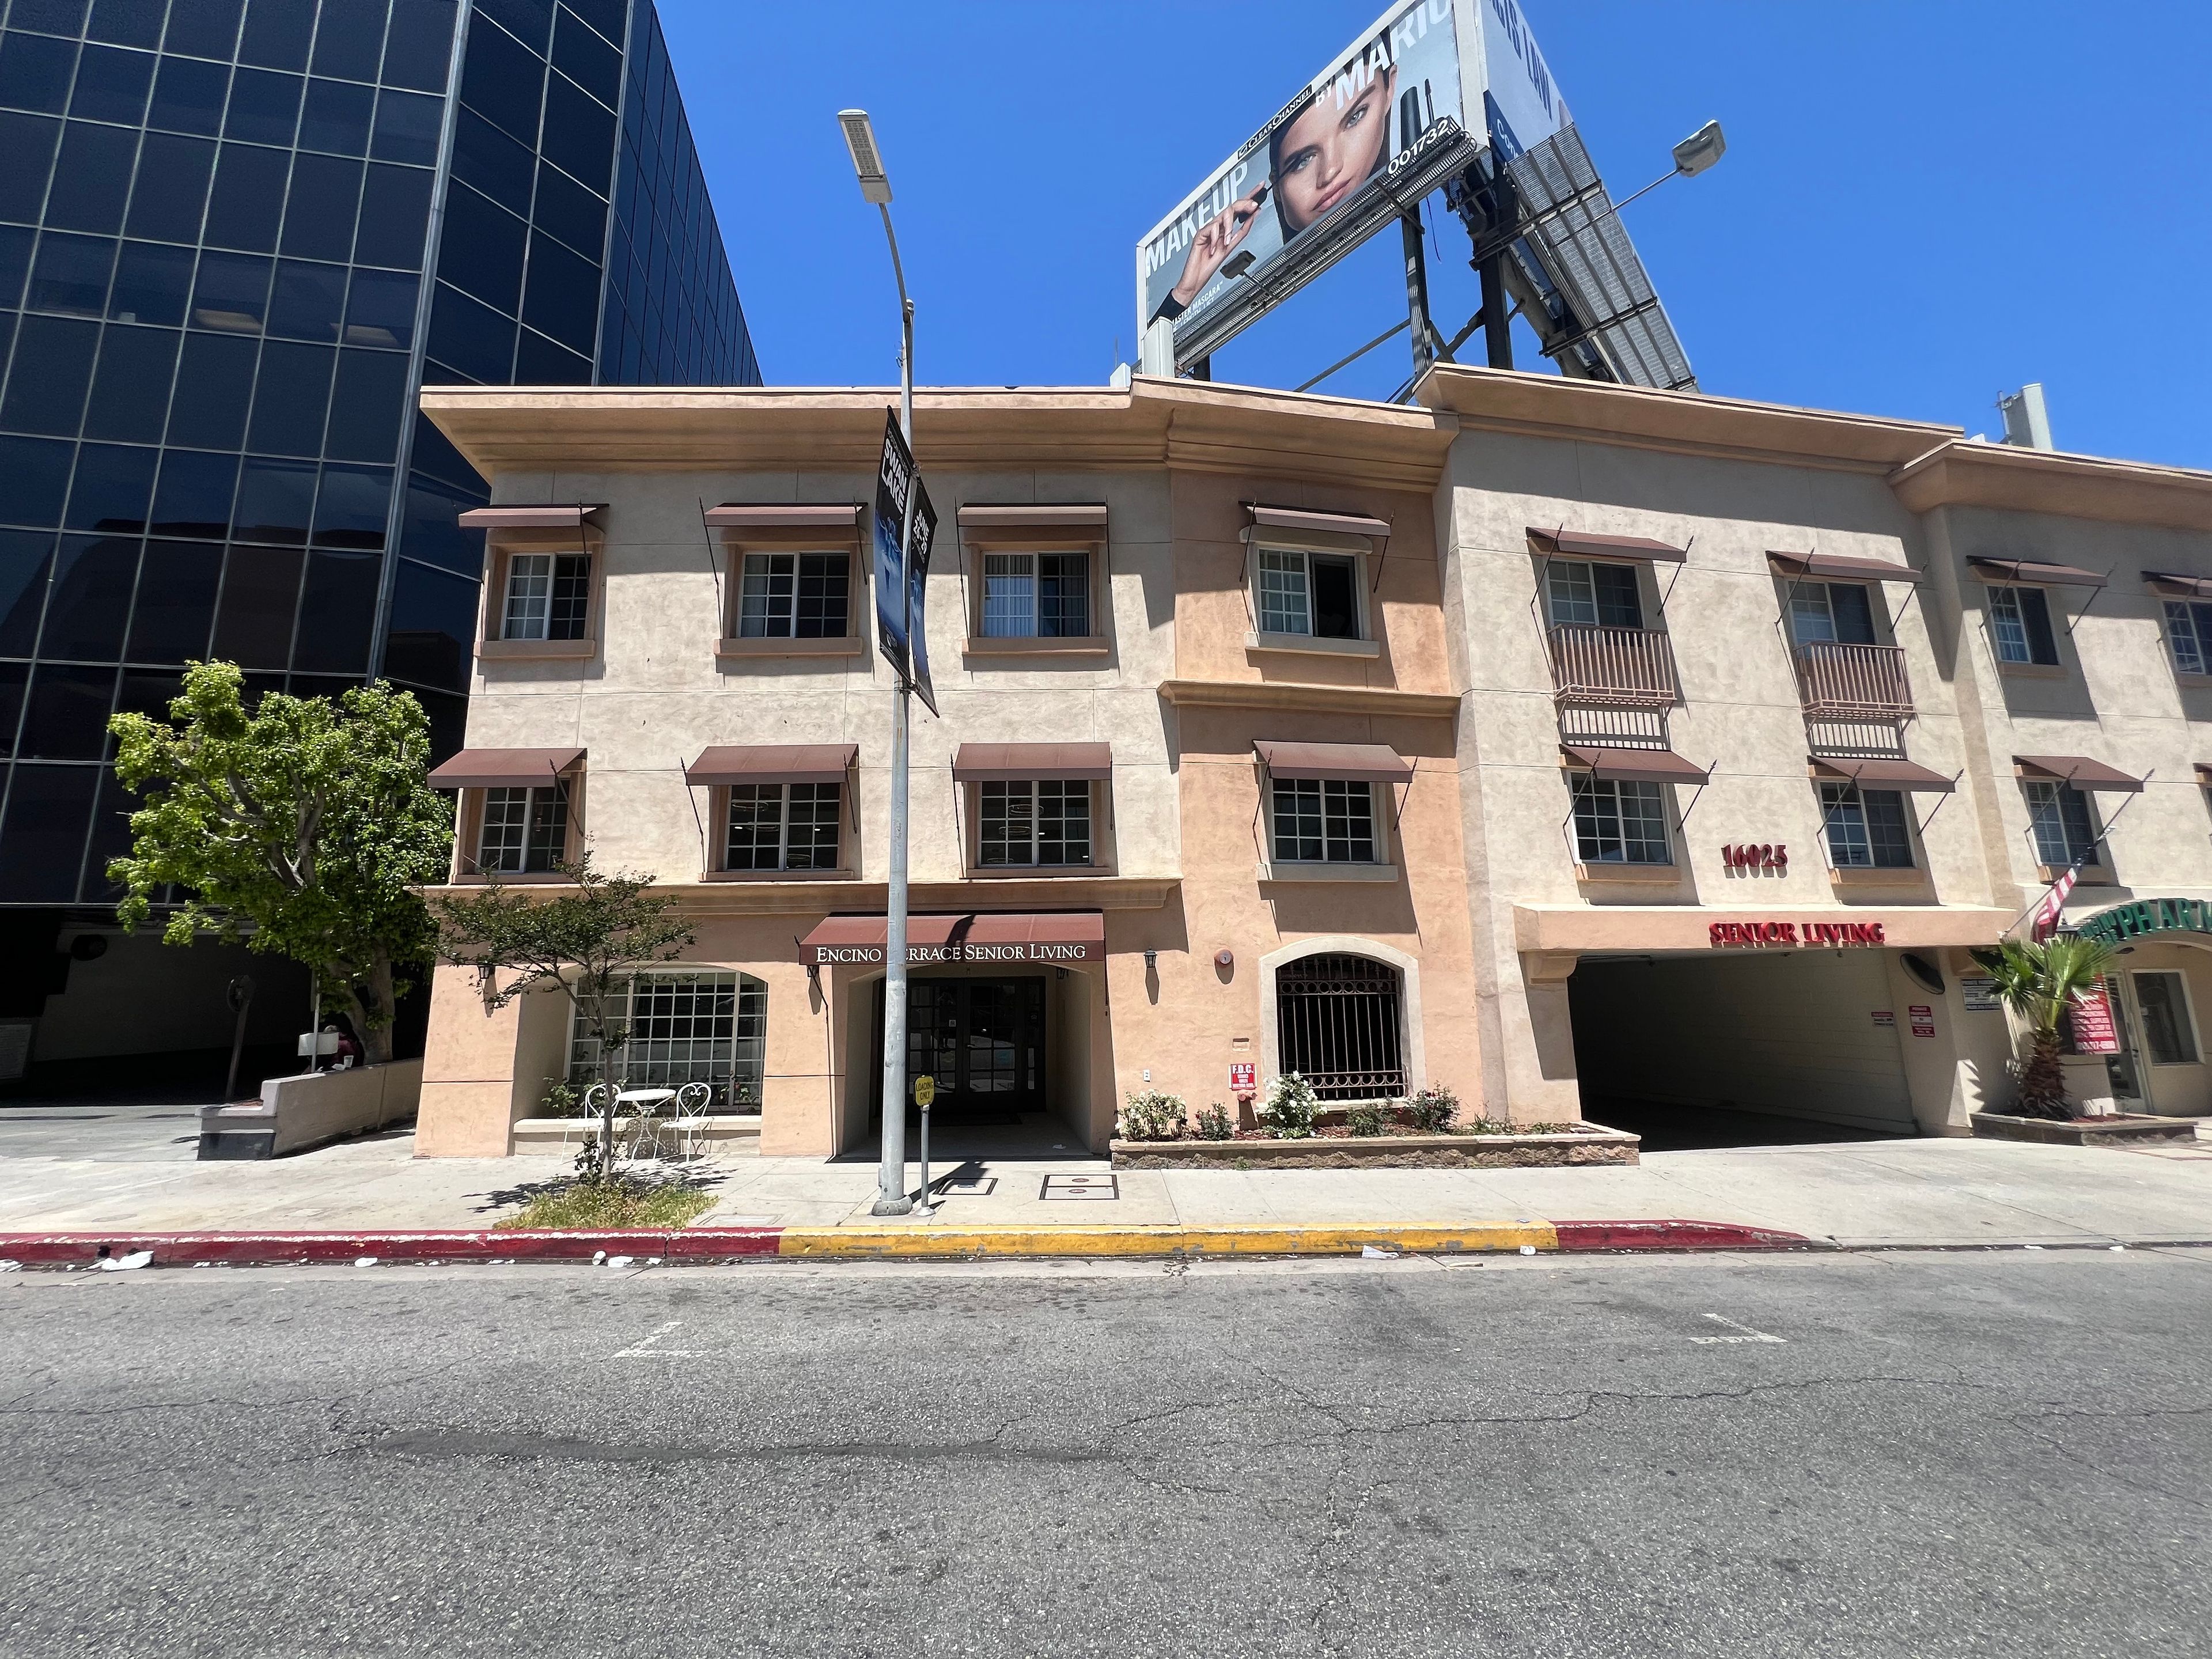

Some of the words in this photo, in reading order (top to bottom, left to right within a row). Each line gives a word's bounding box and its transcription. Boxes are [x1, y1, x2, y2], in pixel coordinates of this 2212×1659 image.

[1316, 82, 1332, 108] BY
[1388, 119, 1449, 175] 001732
[1146, 162, 1248, 279] MAKEUP
[884, 438, 907, 494] SWAN
[881, 456, 905, 514] LAKE
[916, 509, 930, 541] JUNE
[1721, 844, 1787, 866] 16025
[1709, 922, 1800, 943] SENIOR
[1801, 922, 1885, 943] LIVING
[816, 946, 882, 962] ENCINO
[887, 947, 961, 961] RRACE
[964, 944, 1026, 960] SENIOR
[1029, 944, 1086, 959] LIVING
[1232, 1064, 1254, 1074] F.D.C.
[916, 1081, 933, 1092] LOADING
[919, 1091, 930, 1100] ONLY
